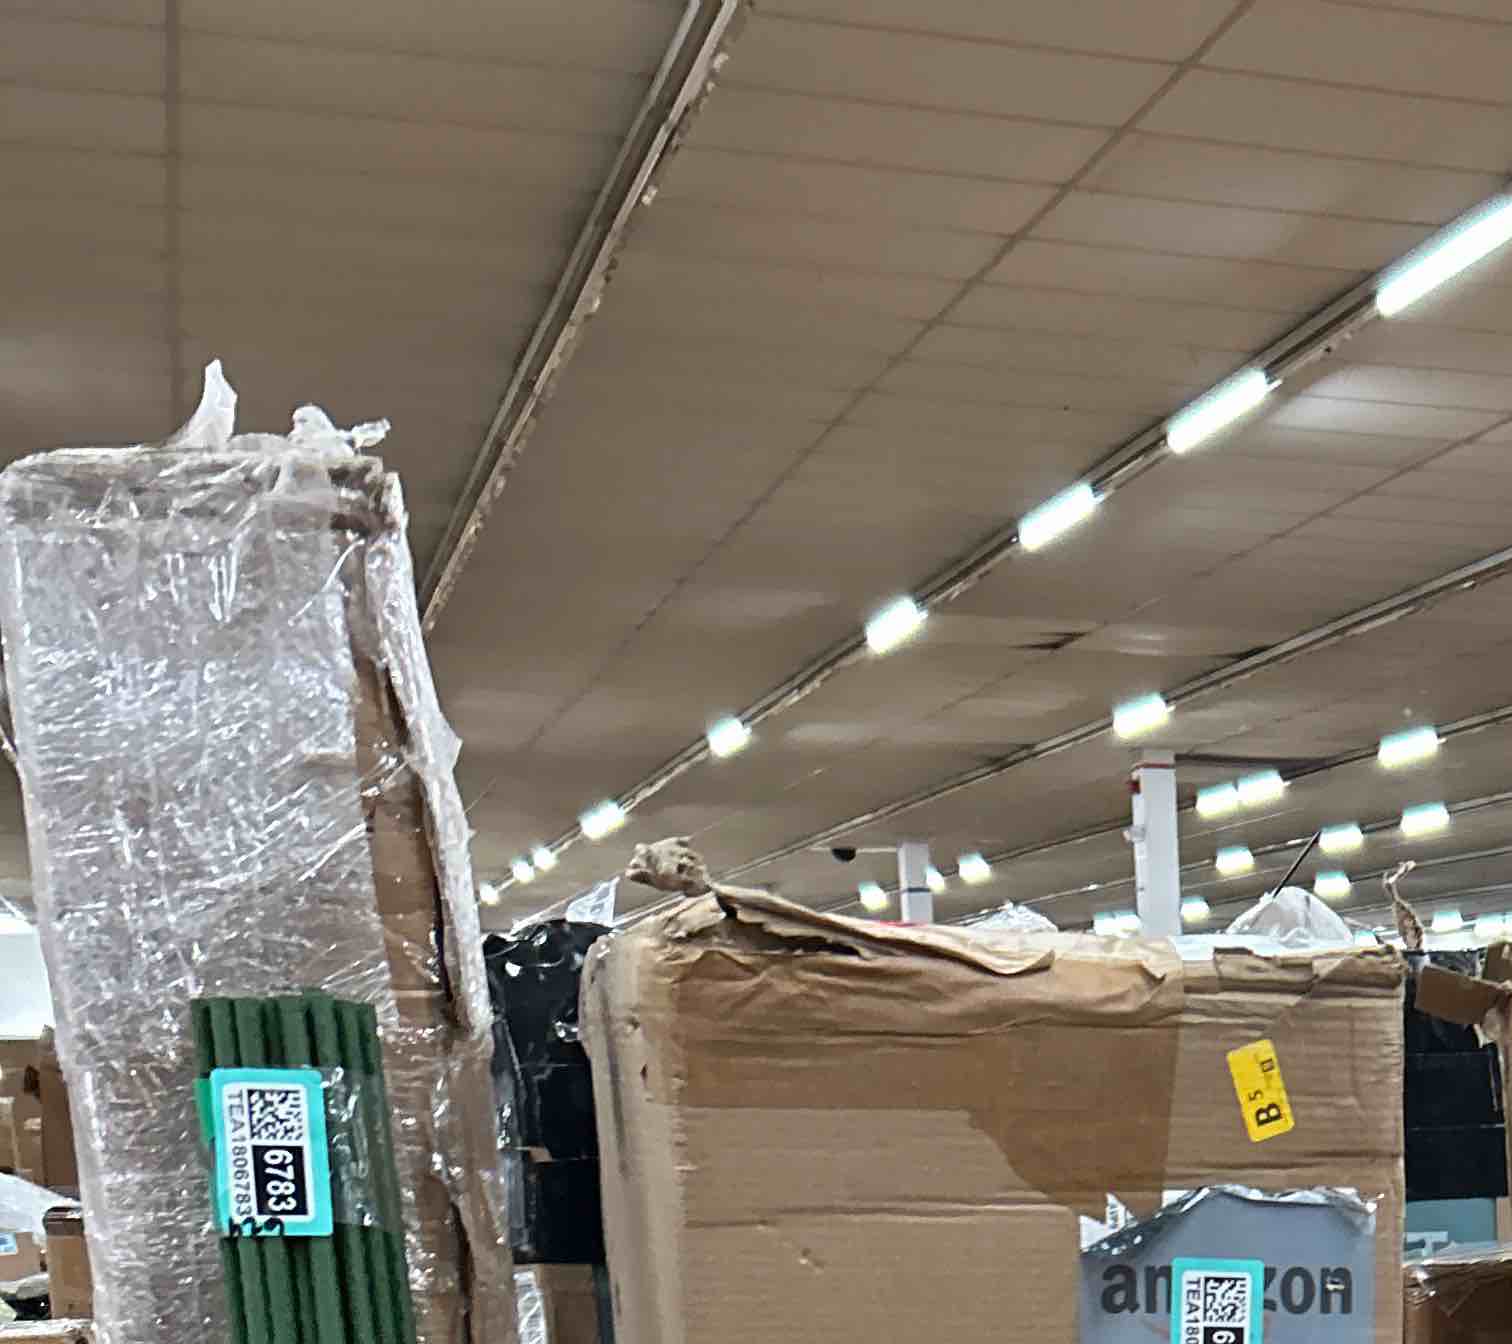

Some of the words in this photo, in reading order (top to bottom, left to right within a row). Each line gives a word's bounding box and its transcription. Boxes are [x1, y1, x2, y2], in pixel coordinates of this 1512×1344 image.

[1255, 1103, 1281, 1126] B
[228, 1088, 252, 1217] TEA1806783
[263, 1149, 297, 1212] 6783
[1101, 1264, 1353, 1314] aon
